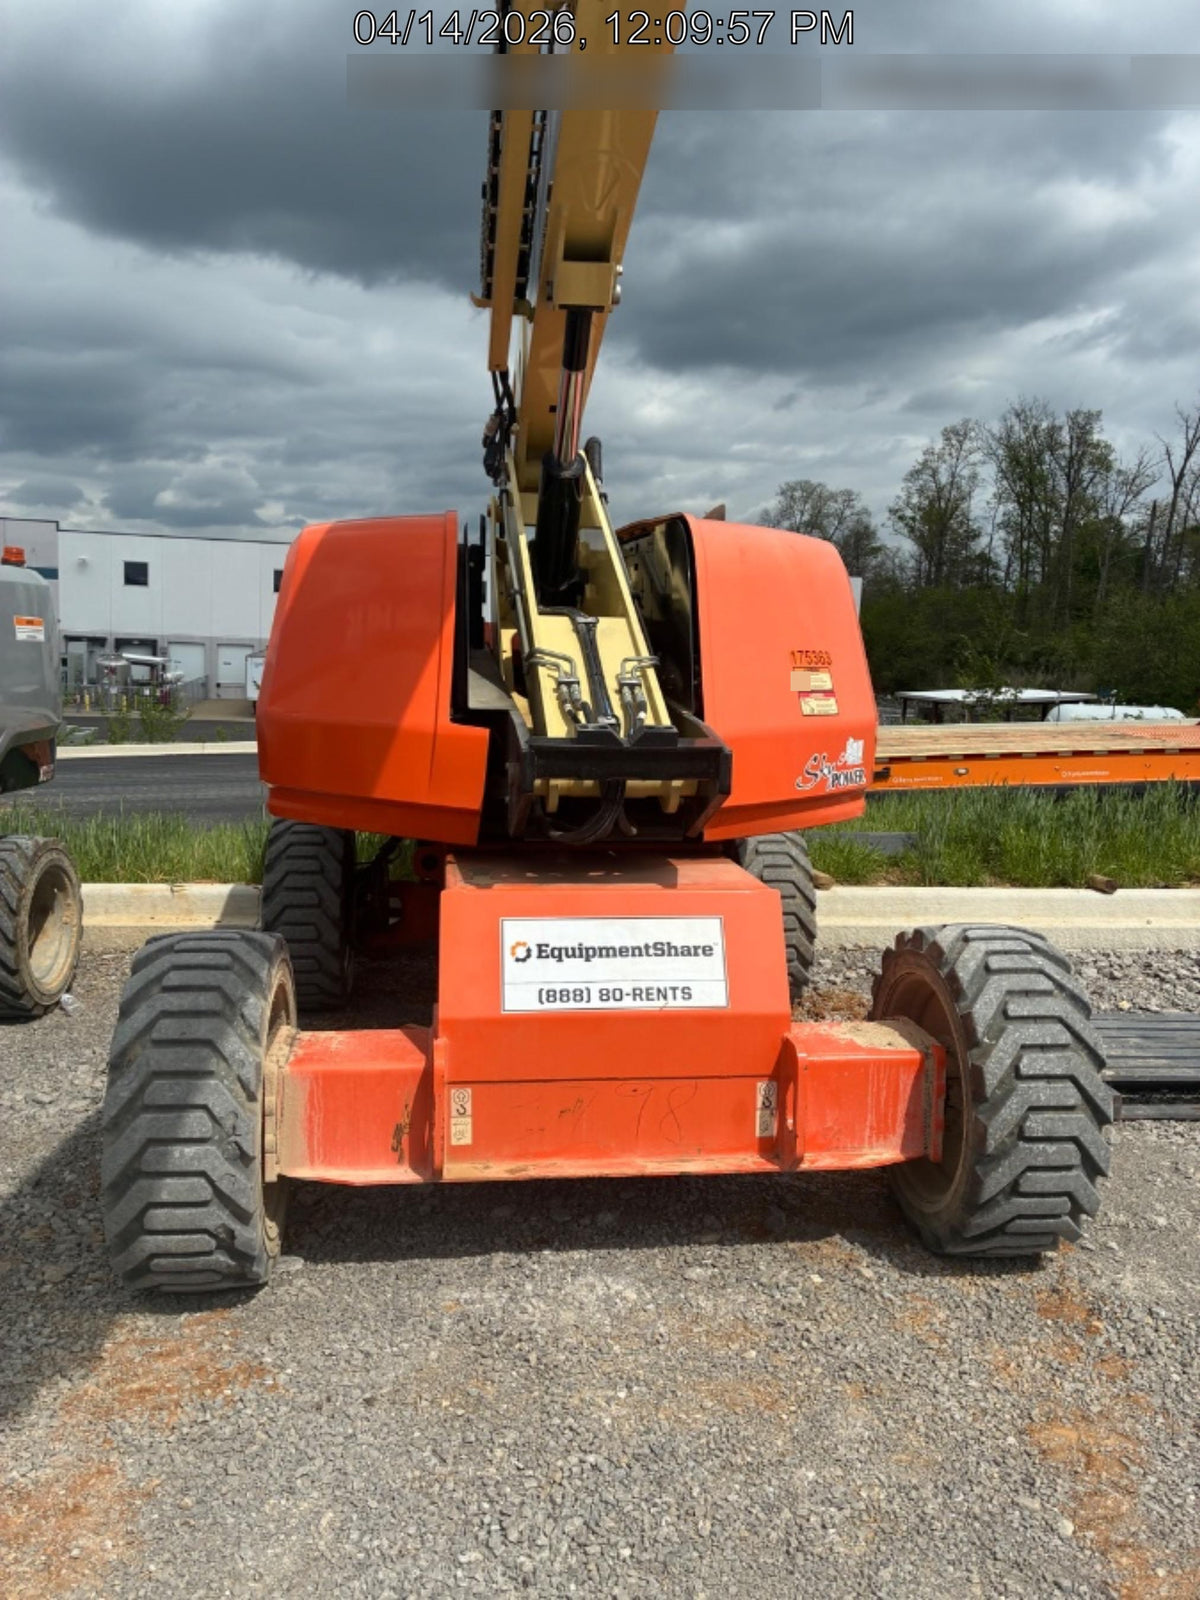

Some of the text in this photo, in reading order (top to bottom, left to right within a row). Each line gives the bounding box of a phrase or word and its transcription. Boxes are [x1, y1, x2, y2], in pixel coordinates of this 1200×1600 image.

[535, 941, 714, 963] EquipmentShare
[538, 986, 693, 1005] (888) 80-RENTS
